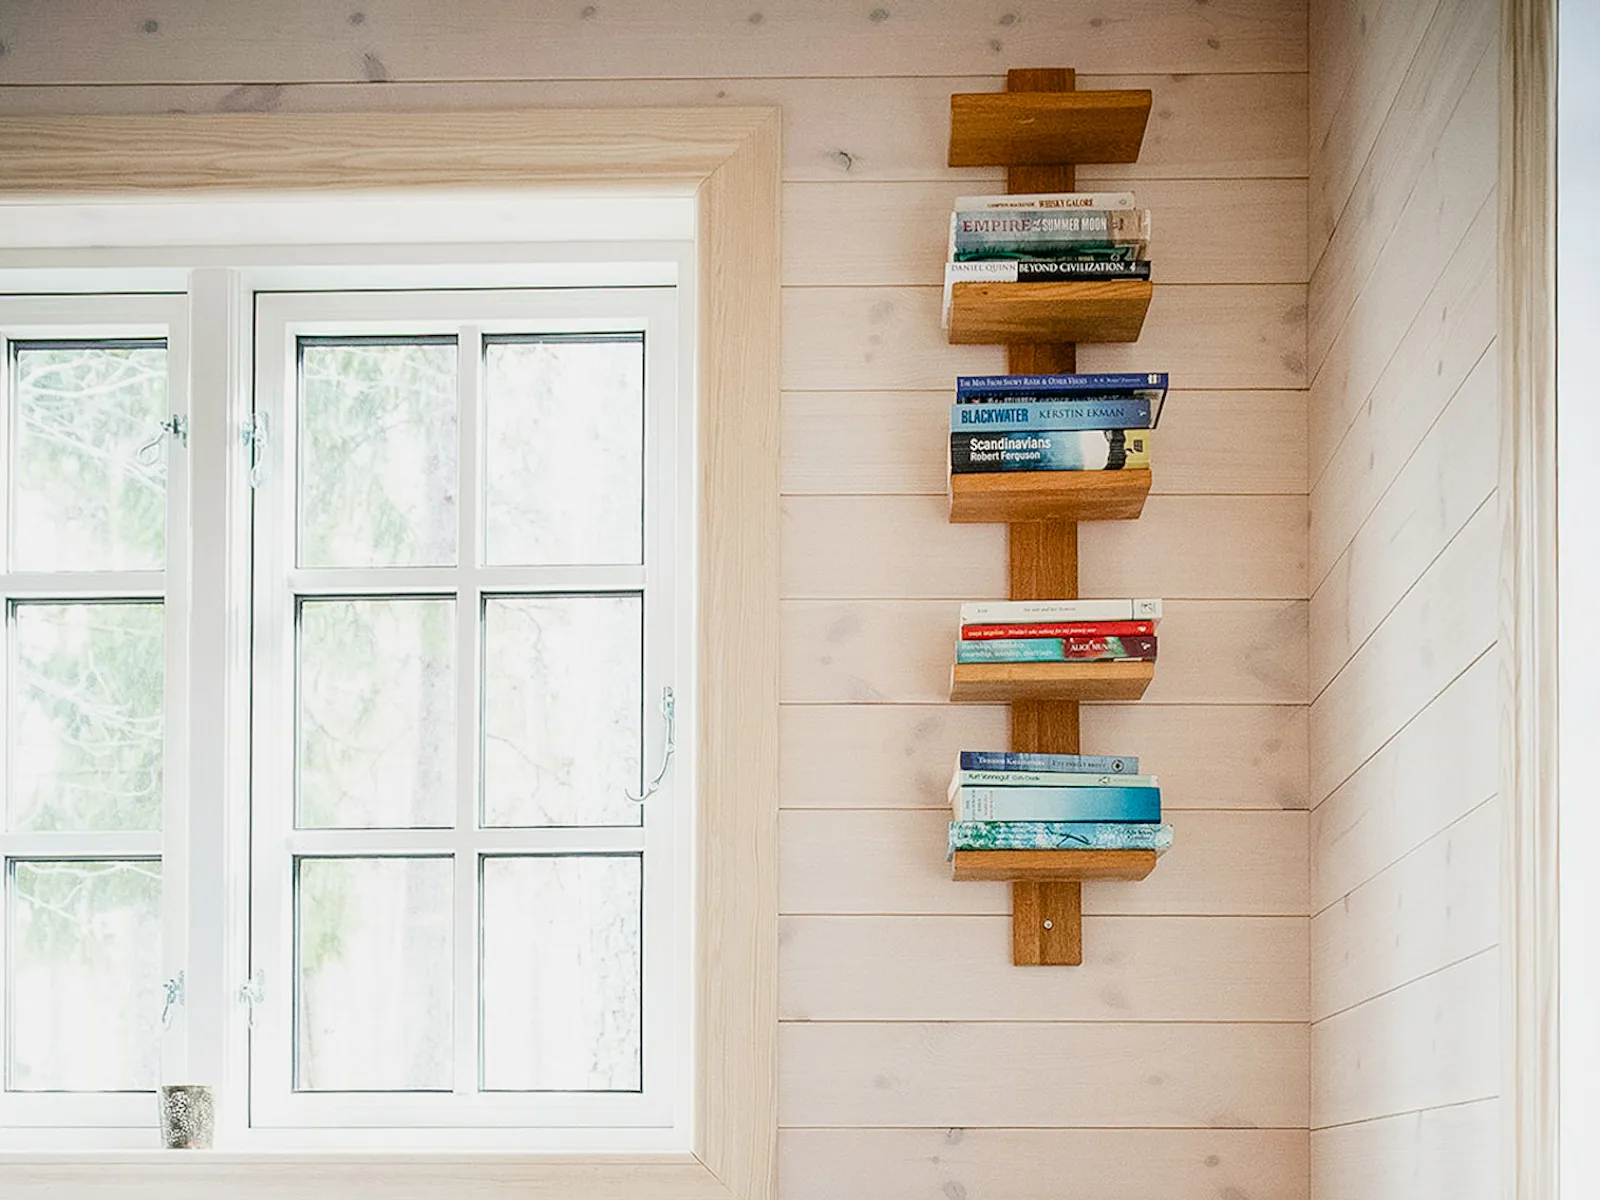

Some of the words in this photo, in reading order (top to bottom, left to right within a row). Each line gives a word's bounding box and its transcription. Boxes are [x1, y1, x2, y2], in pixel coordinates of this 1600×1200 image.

[962, 219, 1030, 233] EMPIRE
[1041, 218, 1080, 232] SUMMER
[1081, 217, 1107, 231] MOON
[951, 264, 984, 272] DANIEL
[985, 264, 1016, 273] QUINN
[1019, 262, 1058, 273] BEYOND
[1059, 261, 1125, 273] CIVILIZATION
[961, 408, 1029, 424] BLACKWATER
[1039, 409, 1083, 418] KERSTIN
[1087, 408, 1125, 417] EKMAN
[969, 437, 1051, 452] Scandinavians
[970, 452, 999, 461] Robert
[1000, 451, 1041, 462] Ferguson
